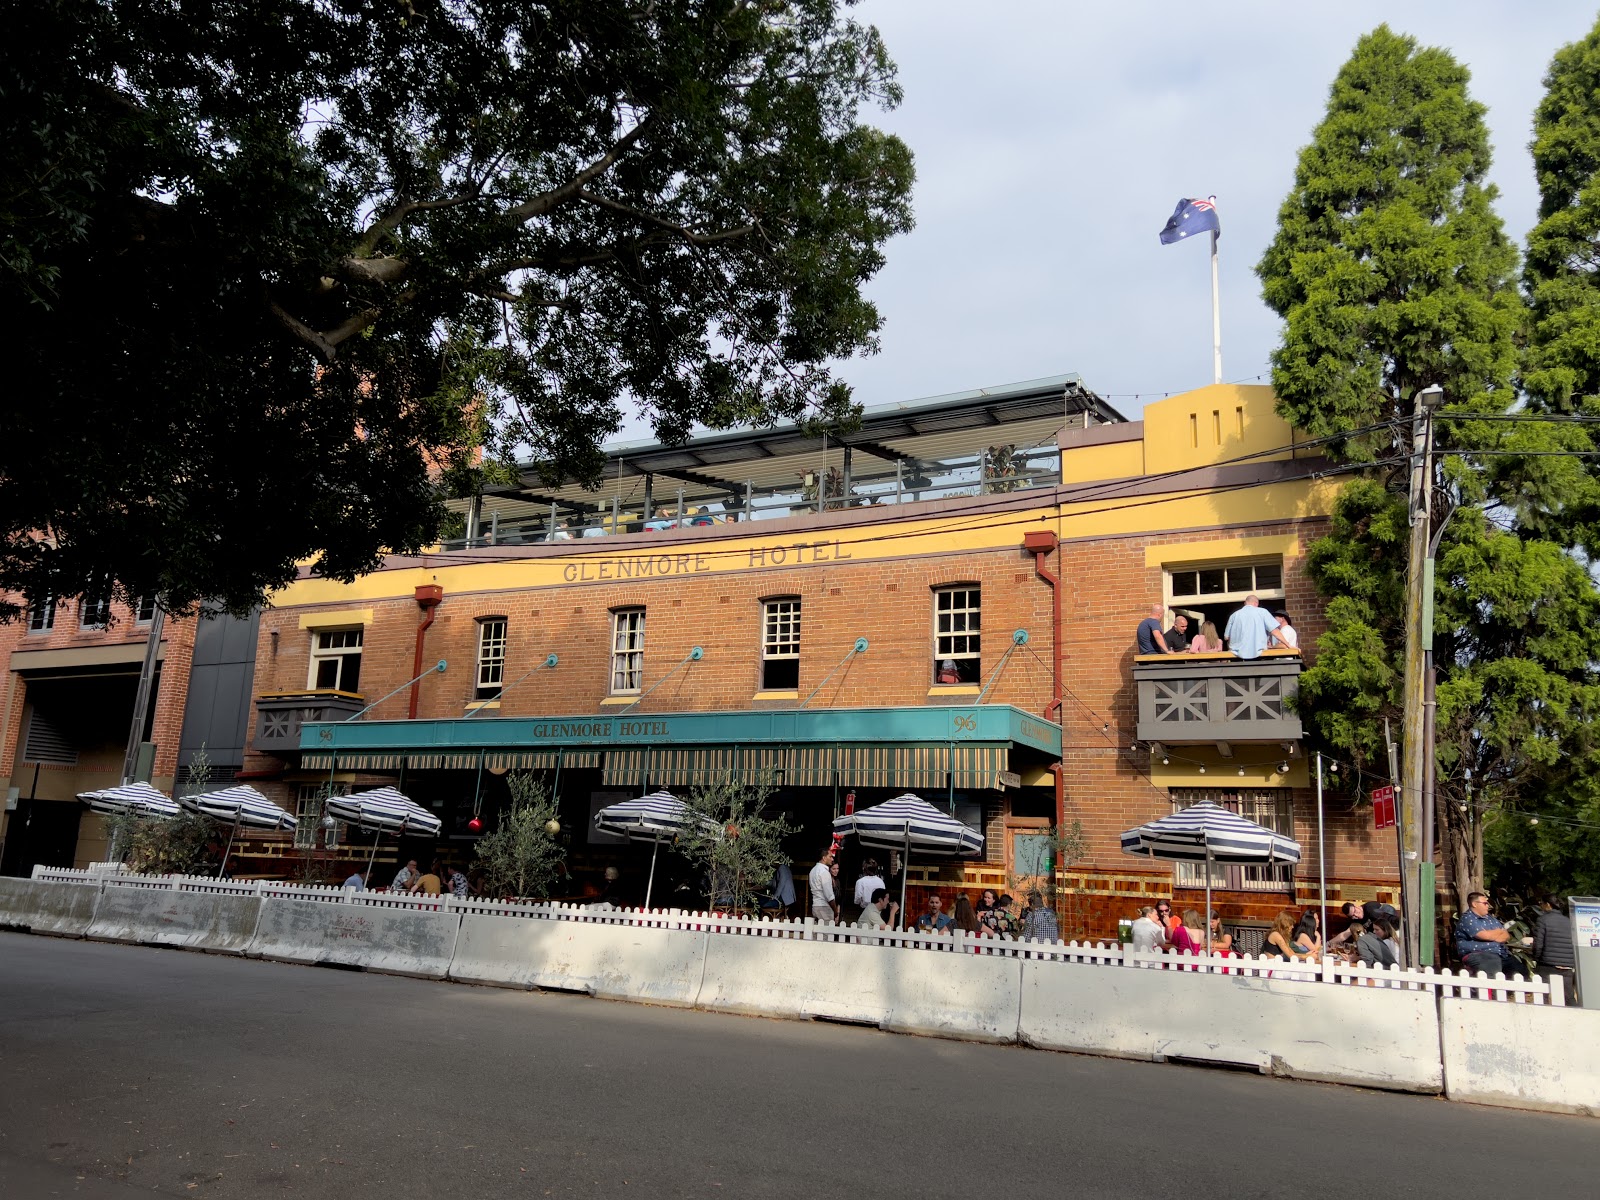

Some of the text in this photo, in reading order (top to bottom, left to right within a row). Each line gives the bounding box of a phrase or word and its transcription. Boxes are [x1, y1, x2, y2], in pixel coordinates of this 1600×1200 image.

[563, 539, 852, 582] GLENMORE HOTEL
[533, 721, 670, 738] GLENMORE HOTEL
[953, 713, 977, 733] 96
[319, 727, 334, 743] 96
